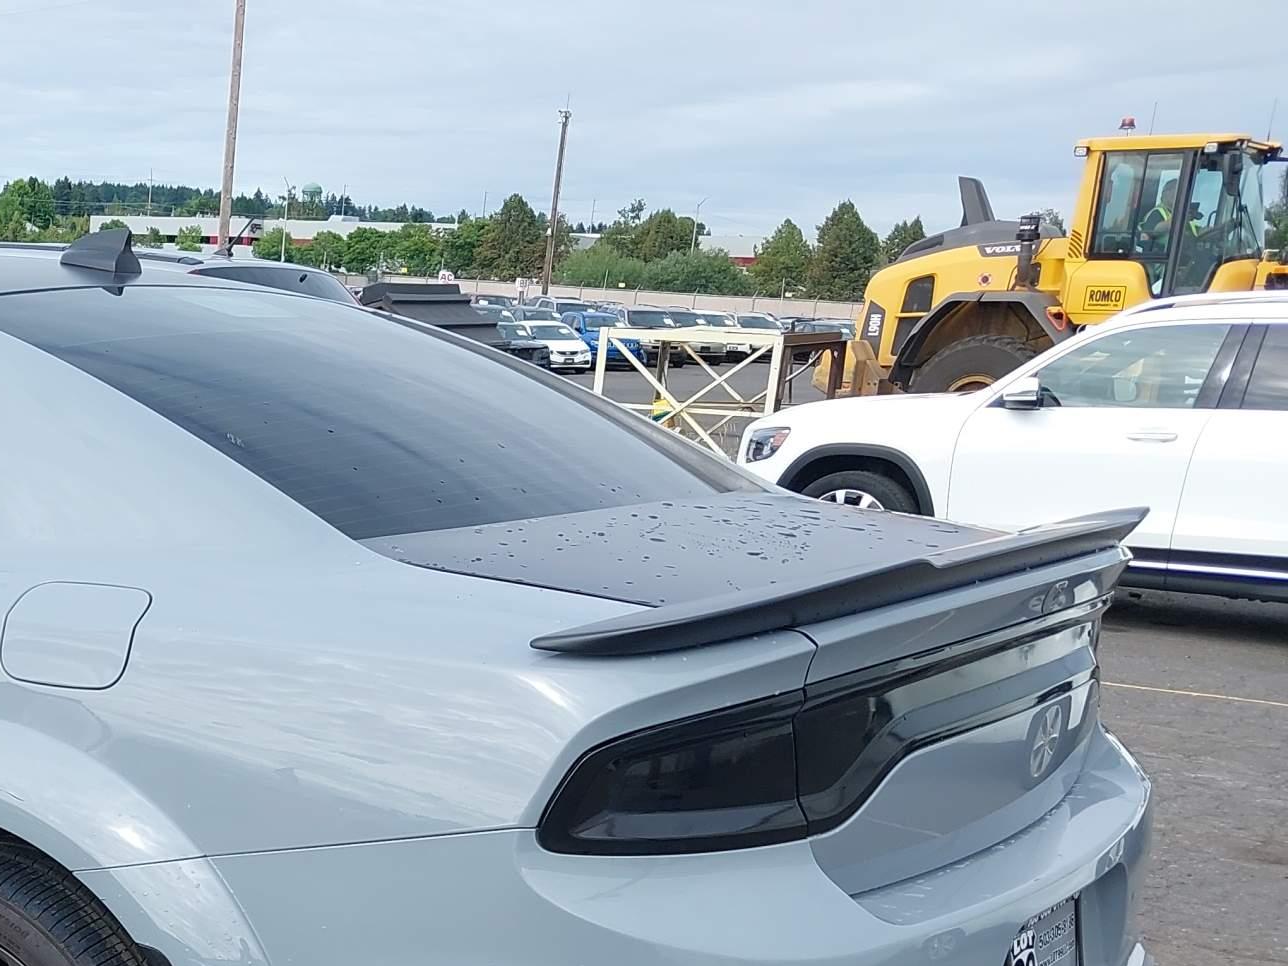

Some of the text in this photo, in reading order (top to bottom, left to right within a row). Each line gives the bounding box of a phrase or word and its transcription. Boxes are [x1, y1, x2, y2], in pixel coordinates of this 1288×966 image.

[984, 244, 1036, 254] VOLV
[1088, 289, 1122, 303] ROMCO
[867, 313, 882, 336] L90H
[1013, 929, 1035, 956] LOT
